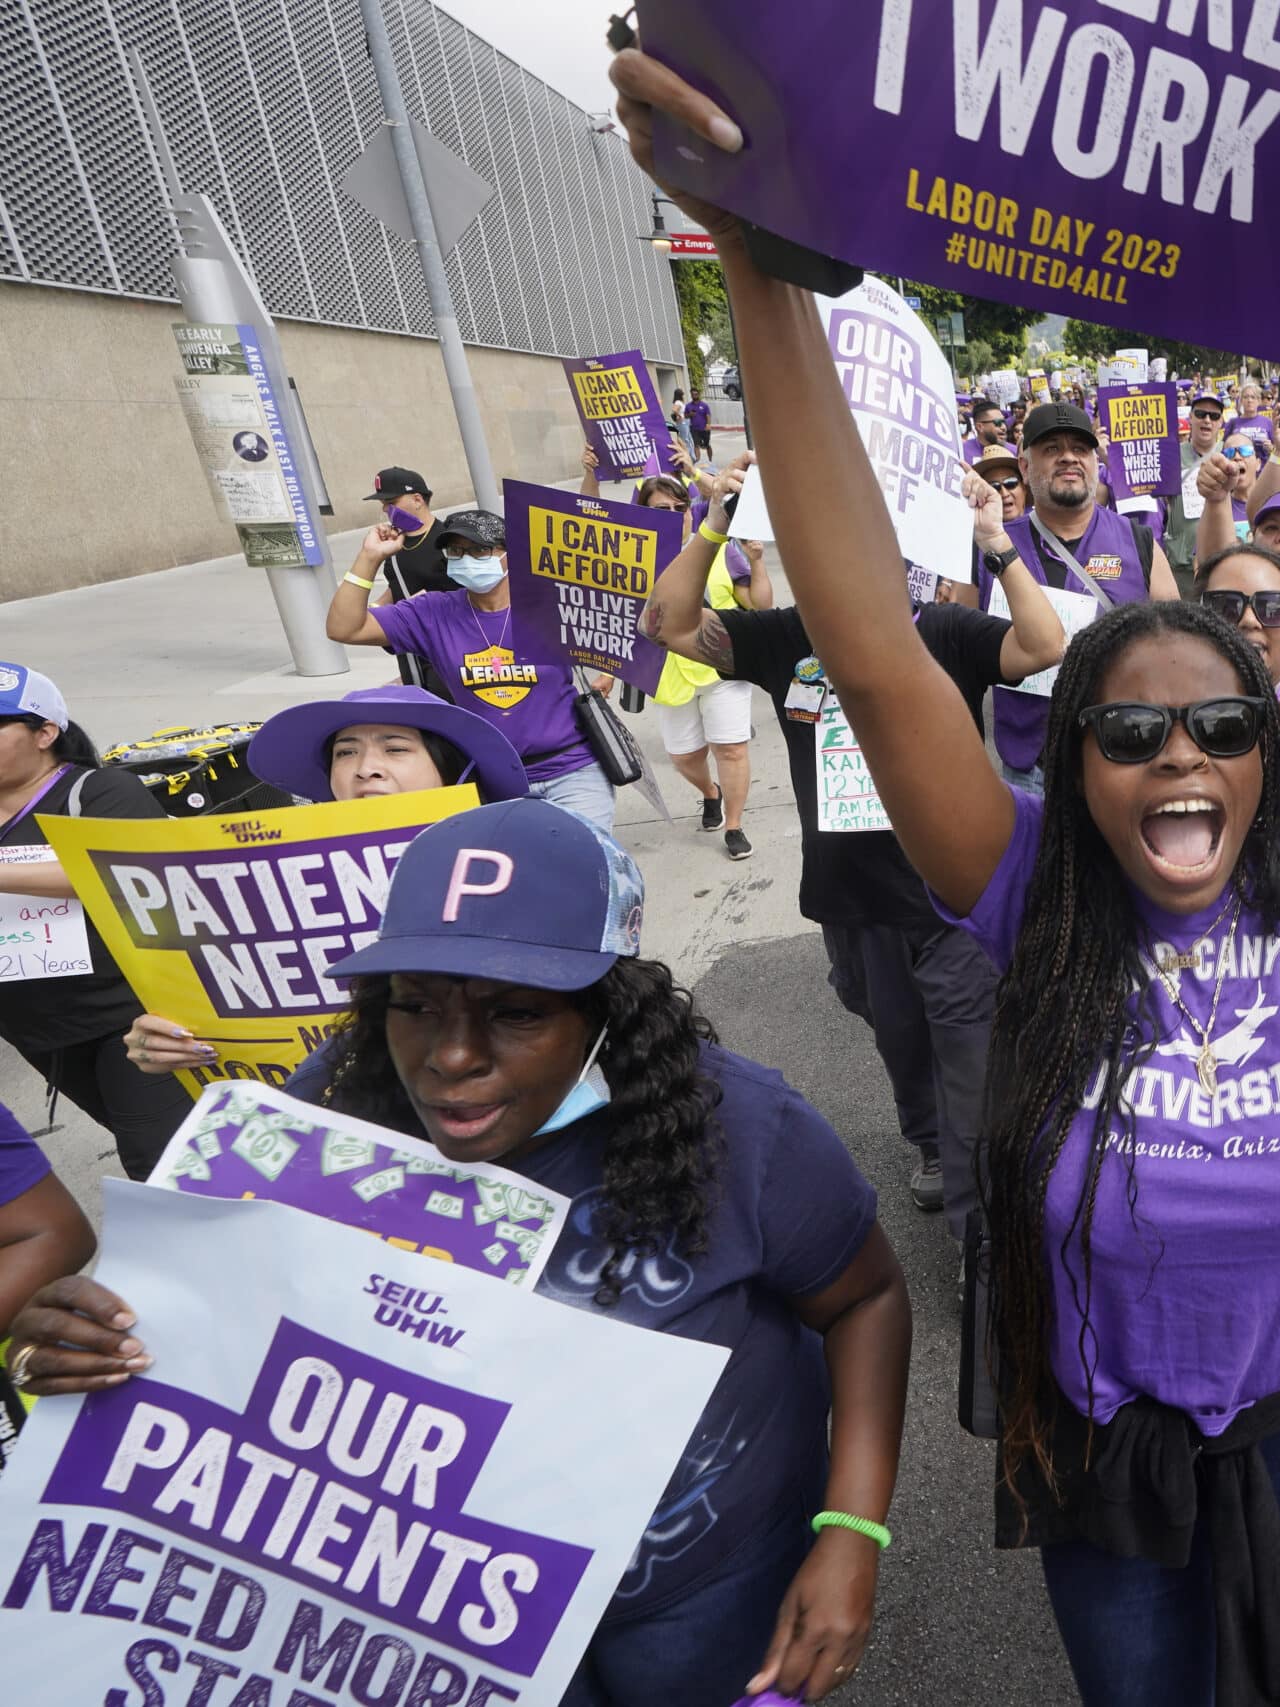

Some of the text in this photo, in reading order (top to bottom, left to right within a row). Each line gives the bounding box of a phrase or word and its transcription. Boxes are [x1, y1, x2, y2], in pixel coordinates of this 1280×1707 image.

[905, 168, 1182, 278] LABOR DAY 2023
[685, 240, 715, 250] Emerg
[945, 232, 1128, 304] #UNITED4ALL
[186, 328, 222, 342] EARLY
[837, 318, 914, 379] OUR
[585, 371, 632, 395] CAN'T
[583, 392, 643, 416] AFFORD
[836, 363, 952, 442] TIENTS
[1116, 398, 1161, 418] I CAN'T
[597, 416, 645, 436] TO LIVE
[603, 431, 650, 451] WHERE
[1113, 418, 1164, 439] AFFORD
[245, 344, 315, 548] ANGELS WALK EAST HOLLYWOOD
[616, 446, 652, 465] WORK
[868, 420, 962, 498] MORE
[1121, 440, 1160, 455] TO LIVE
[1122, 455, 1161, 471] WHERE
[1130, 470, 1162, 485] WORK
[546, 515, 649, 563] I CAN'T
[538, 547, 648, 594] AFFORD
[555, 582, 637, 618] TO LIVE
[558, 604, 636, 638] WHERE
[560, 624, 636, 661] I WORK
[570, 650, 590, 661] LABOR
[593, 655, 606, 664] DAY
[460, 664, 538, 687] LEADER
[823, 754, 861, 772] KAI
[236, 829, 282, 843] UHW
[442, 848, 514, 923] P
[19, 898, 69, 921] and
[33, 950, 89, 974] Years
[200, 930, 379, 1010] NEE
[297, 1024, 338, 1054] NO
[363, 1273, 448, 1315] SEIU-
[373, 1303, 466, 1348] UHW
[268, 1355, 467, 1510] OUR
[101, 1401, 540, 1647] PATIENTS
[2, 1518, 268, 1653] NEED
